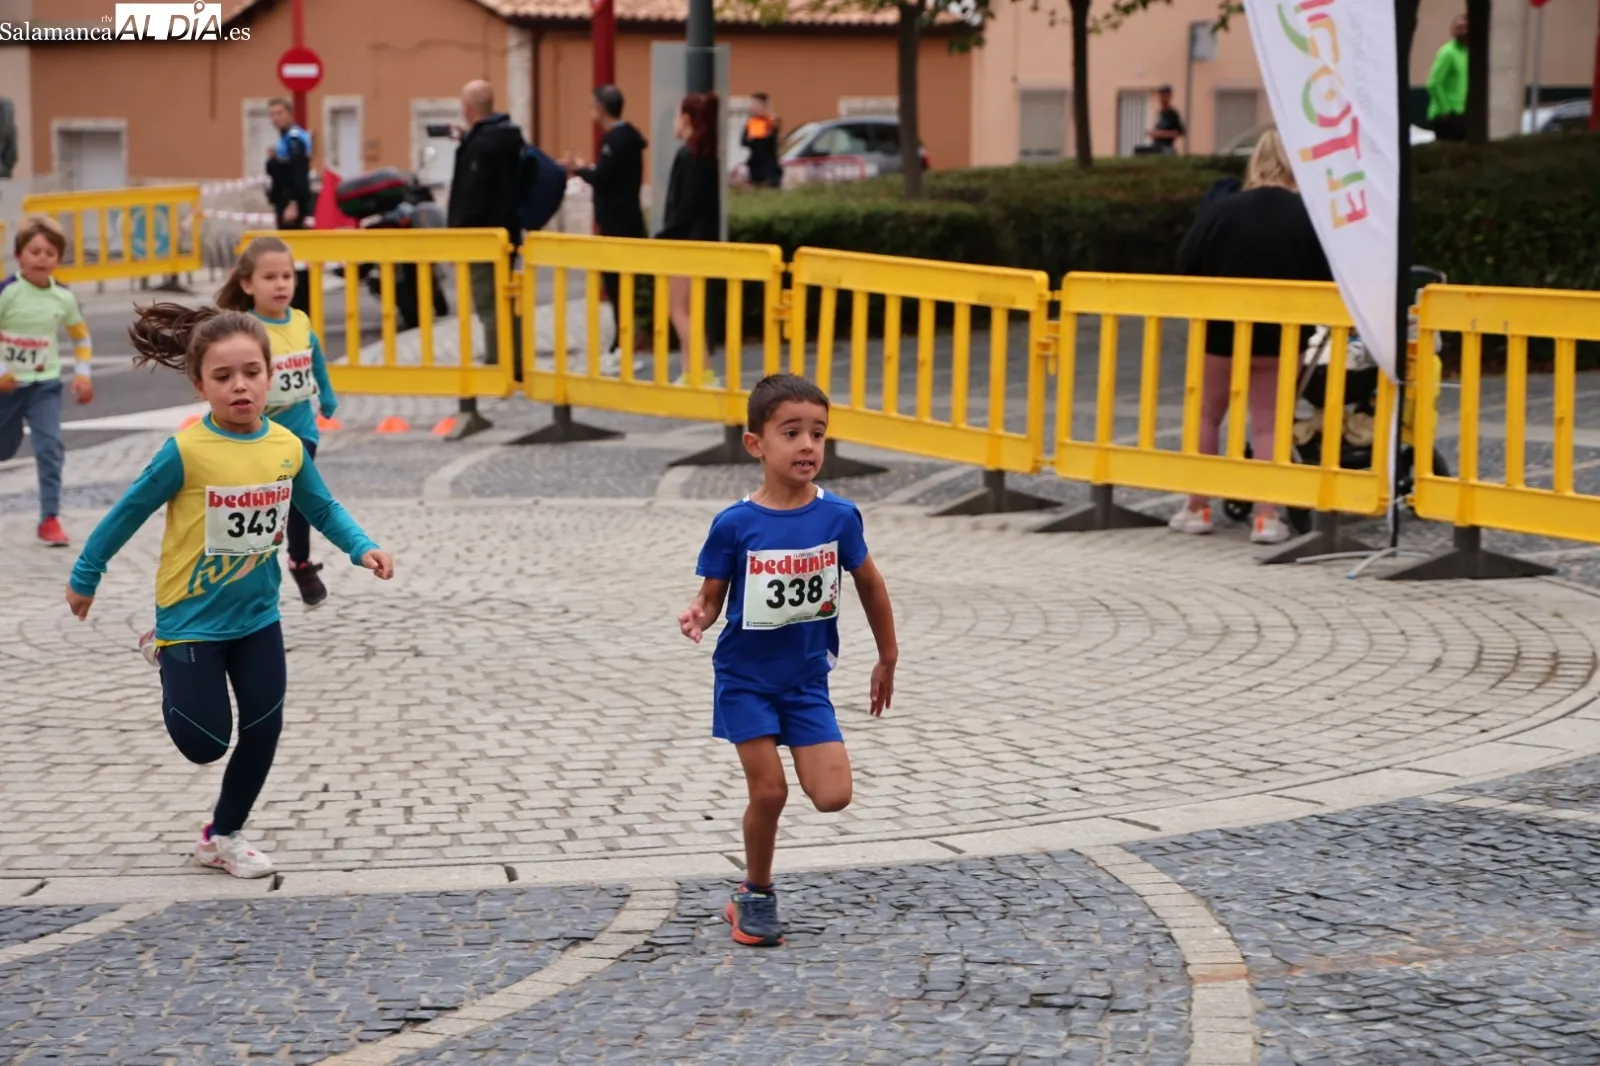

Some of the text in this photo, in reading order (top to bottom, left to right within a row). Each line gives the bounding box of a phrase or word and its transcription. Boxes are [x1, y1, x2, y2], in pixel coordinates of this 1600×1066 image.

[208, 486, 290, 508] bedunia
[227, 508, 277, 538] 343
[749, 549, 836, 575] bedunia
[766, 575, 823, 609] 338
